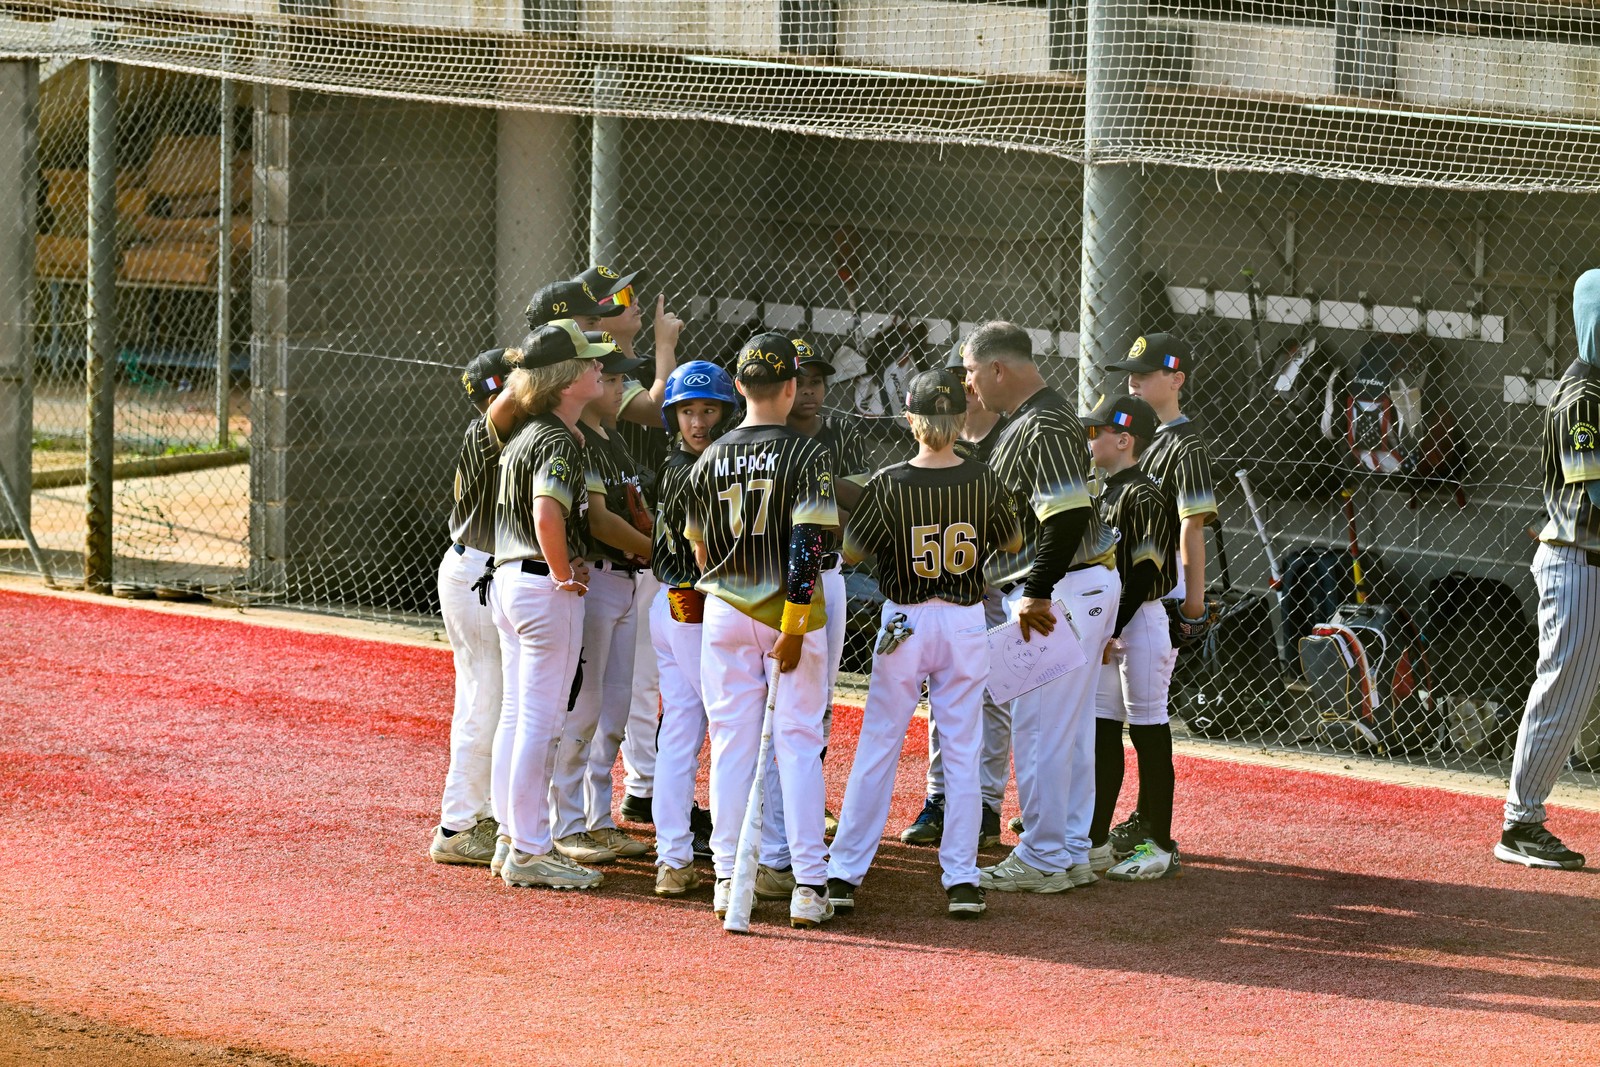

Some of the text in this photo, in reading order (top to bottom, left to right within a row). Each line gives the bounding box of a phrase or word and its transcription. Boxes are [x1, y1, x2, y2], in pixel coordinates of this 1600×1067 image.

[552, 301, 568, 315] 92
[936, 385, 950, 394] TIM
[714, 451, 780, 478] M.PACK
[718, 479, 773, 539] 17
[911, 522, 977, 579] 56
